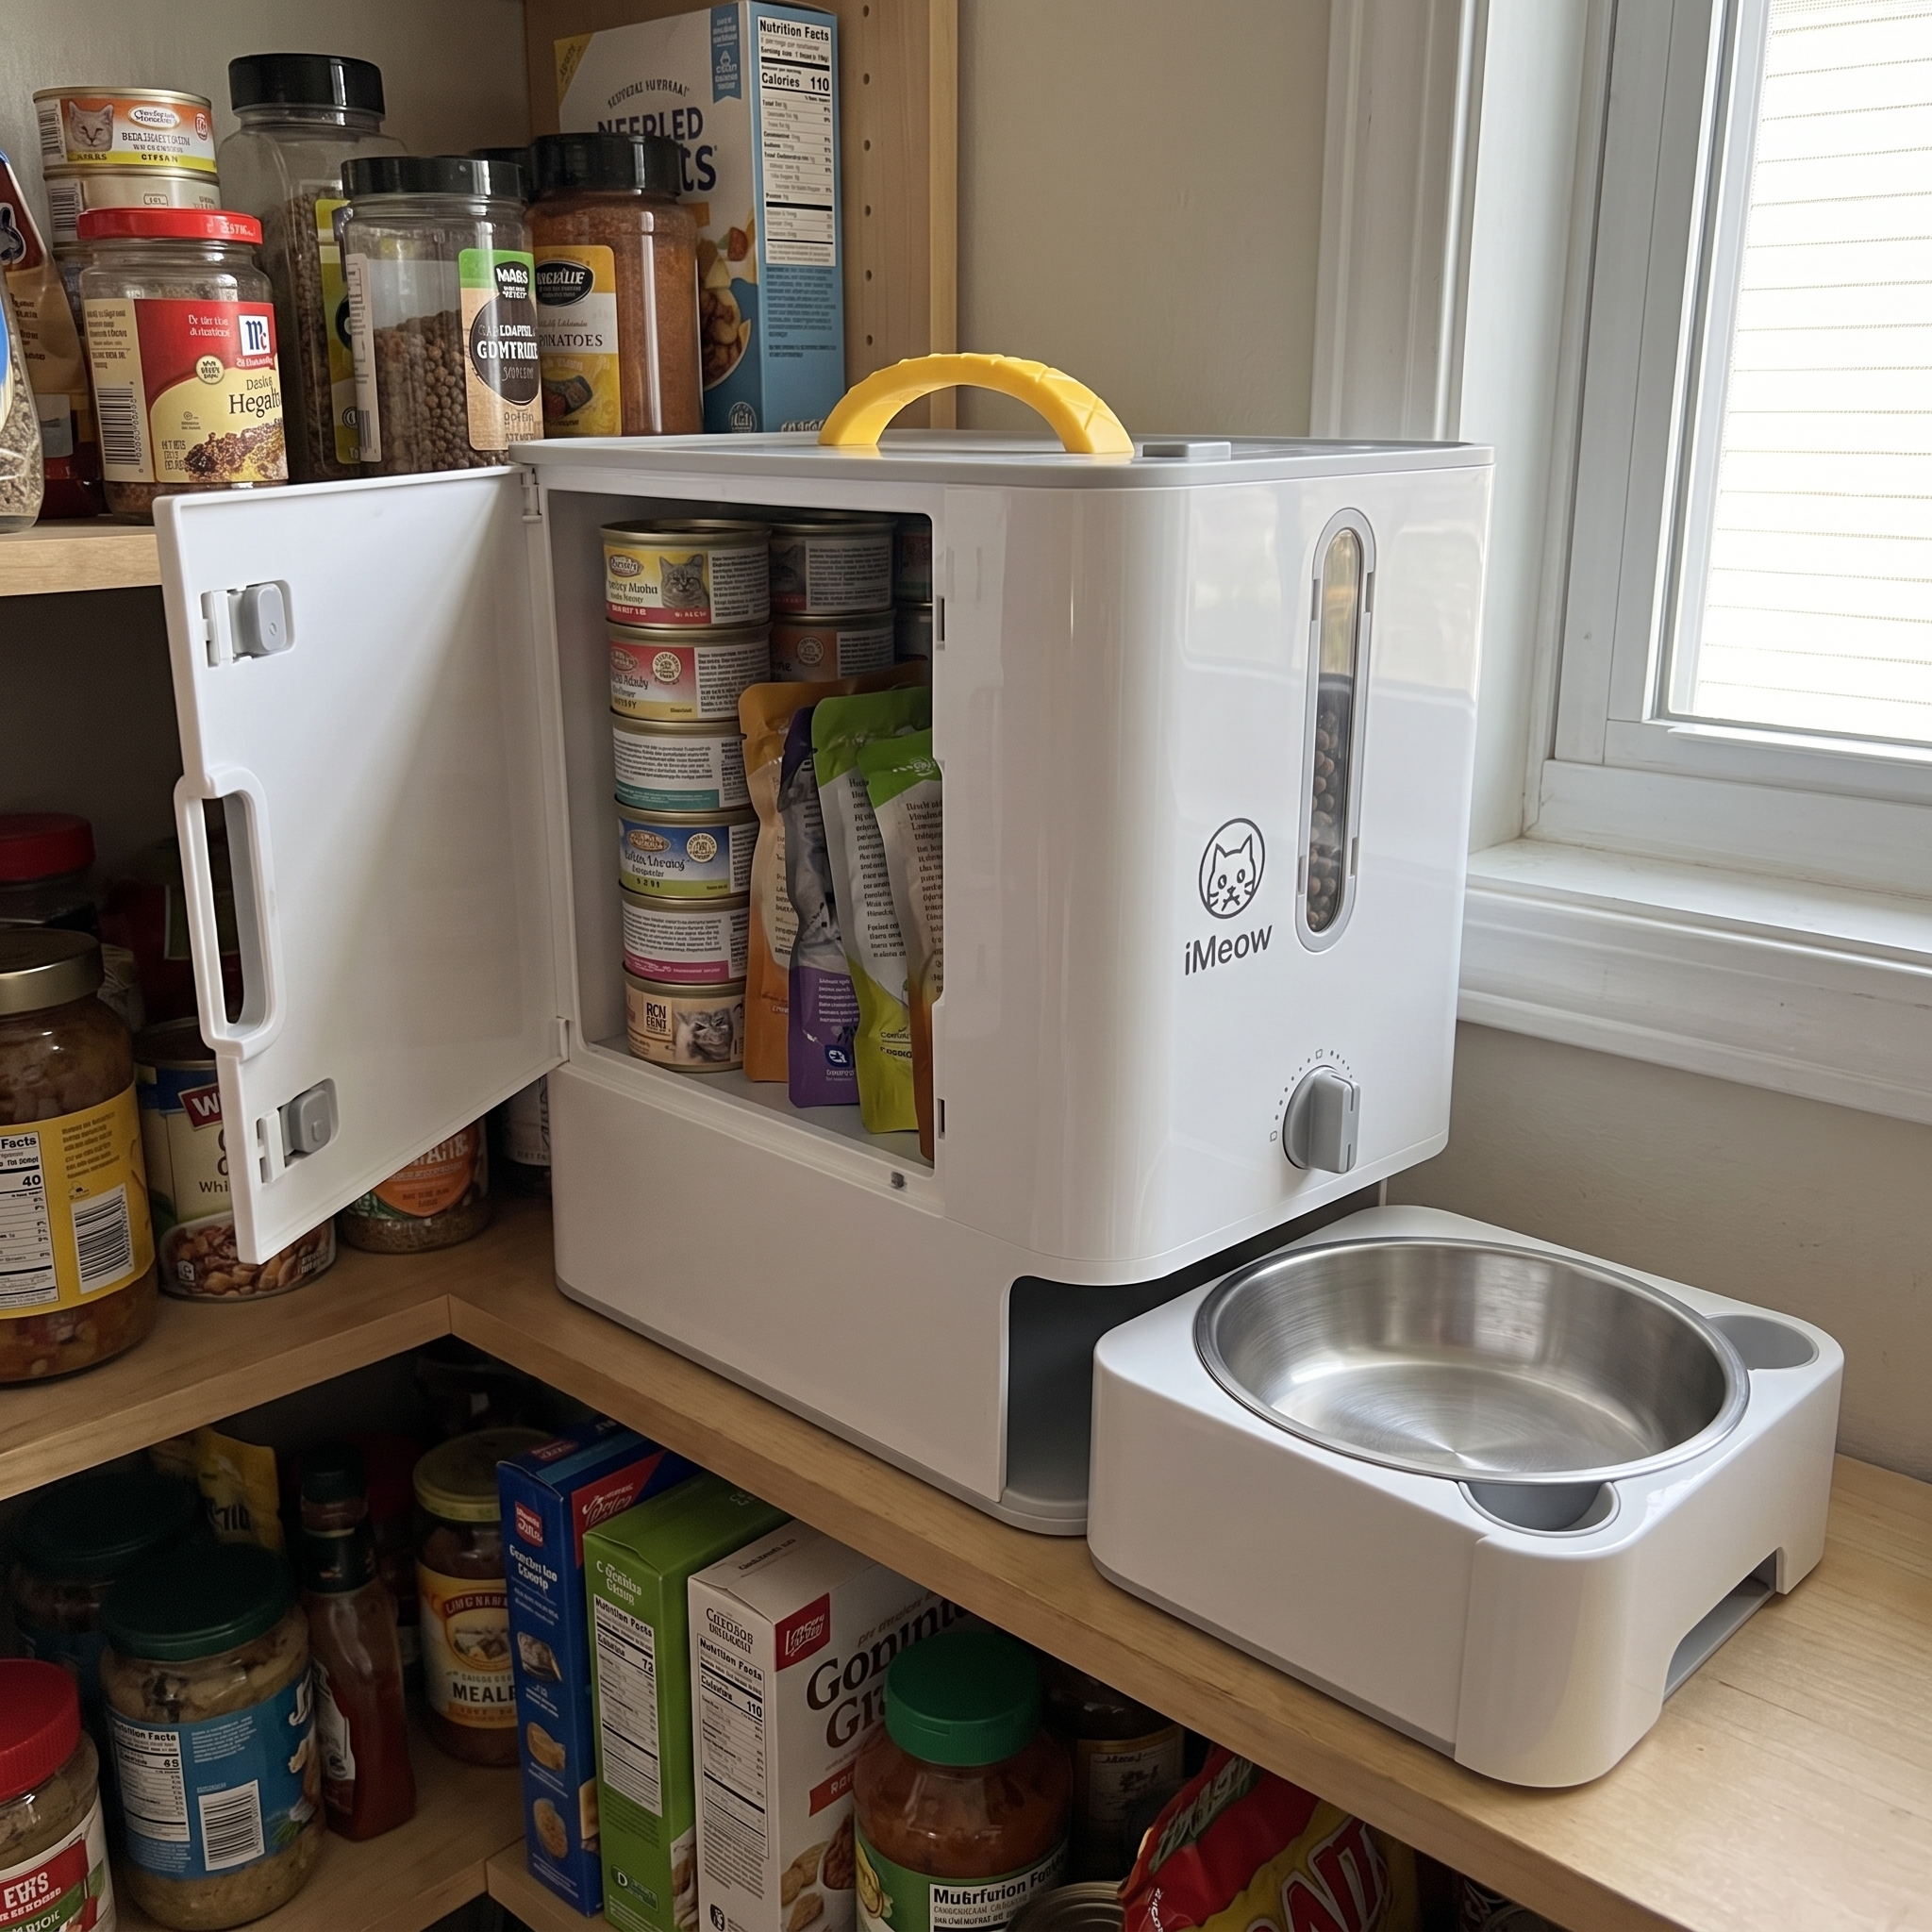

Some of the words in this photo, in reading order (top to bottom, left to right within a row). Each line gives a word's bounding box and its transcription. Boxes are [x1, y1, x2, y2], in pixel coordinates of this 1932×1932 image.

[759, 19, 802, 38] Nutrition
[761, 72, 800, 88] Calories
[810, 76, 829, 92] 110
[1184, 924, 1273, 975] iMeow
[1, 1137, 37, 1149] Facts
[23, 1174, 42, 1187] 40
